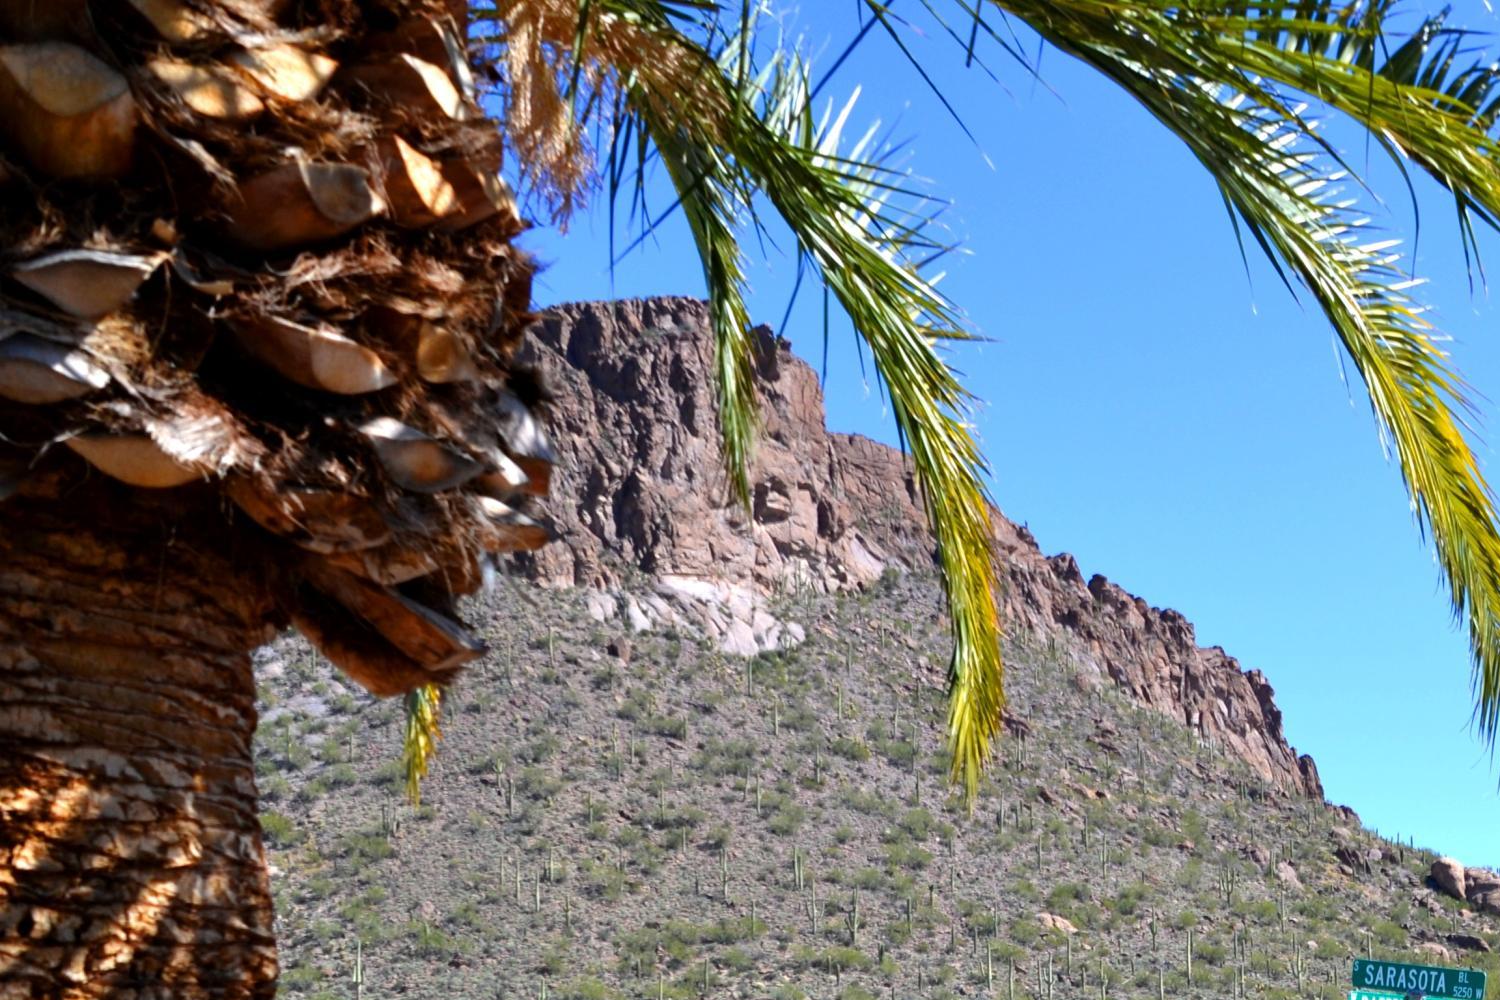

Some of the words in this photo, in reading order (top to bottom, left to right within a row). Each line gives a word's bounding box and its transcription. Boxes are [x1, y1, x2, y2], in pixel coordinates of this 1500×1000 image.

[1353, 959, 1360, 972] S
[1364, 964, 1446, 993] SARASOTA
[1458, 972, 1469, 984] BL
[1453, 986, 1473, 999] 5250
[1475, 987, 1483, 1000] W
